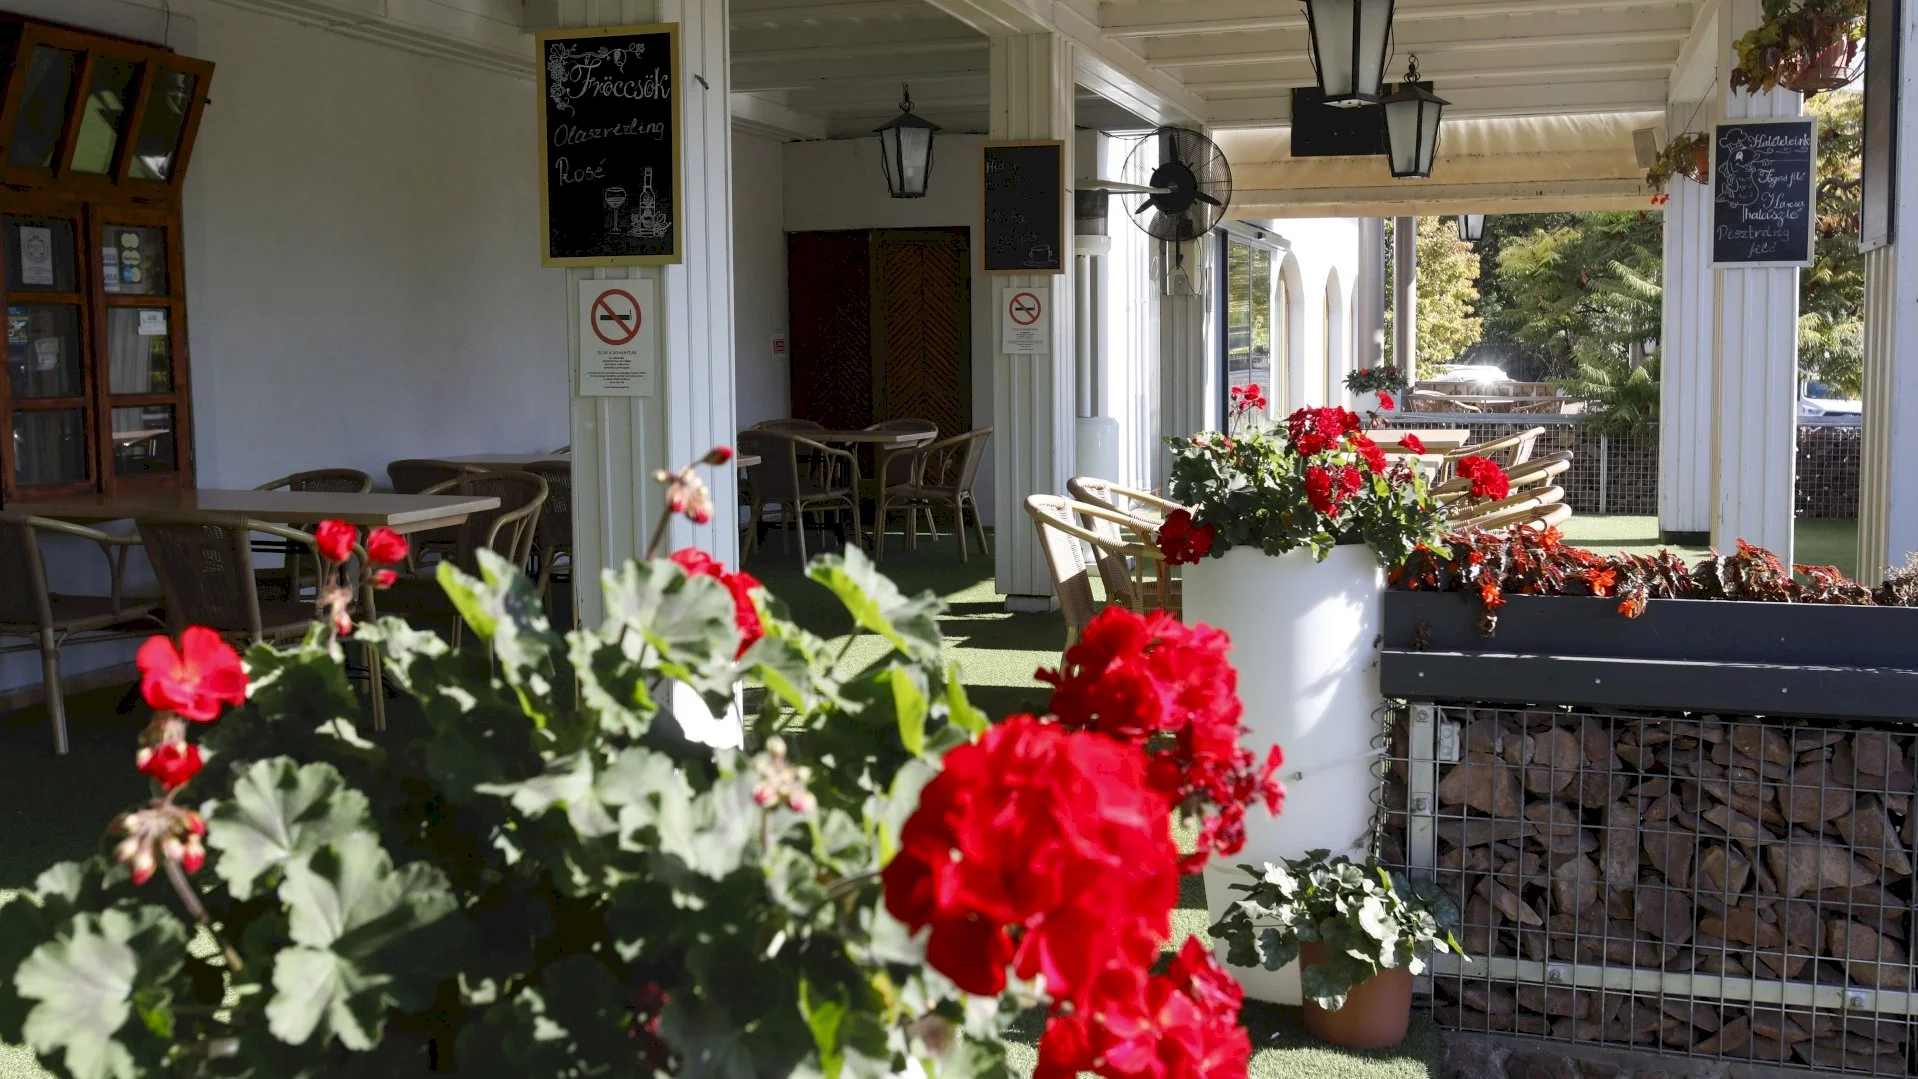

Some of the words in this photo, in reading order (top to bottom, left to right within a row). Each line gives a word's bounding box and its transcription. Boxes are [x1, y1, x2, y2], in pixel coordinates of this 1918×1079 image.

[566, 59, 671, 99] Fröccsök
[554, 118, 665, 147] Olaszrizling
[555, 157, 607, 186] Rosé
[1745, 208, 1803, 227] halászlé
[1717, 224, 1791, 243] Pisztráng
